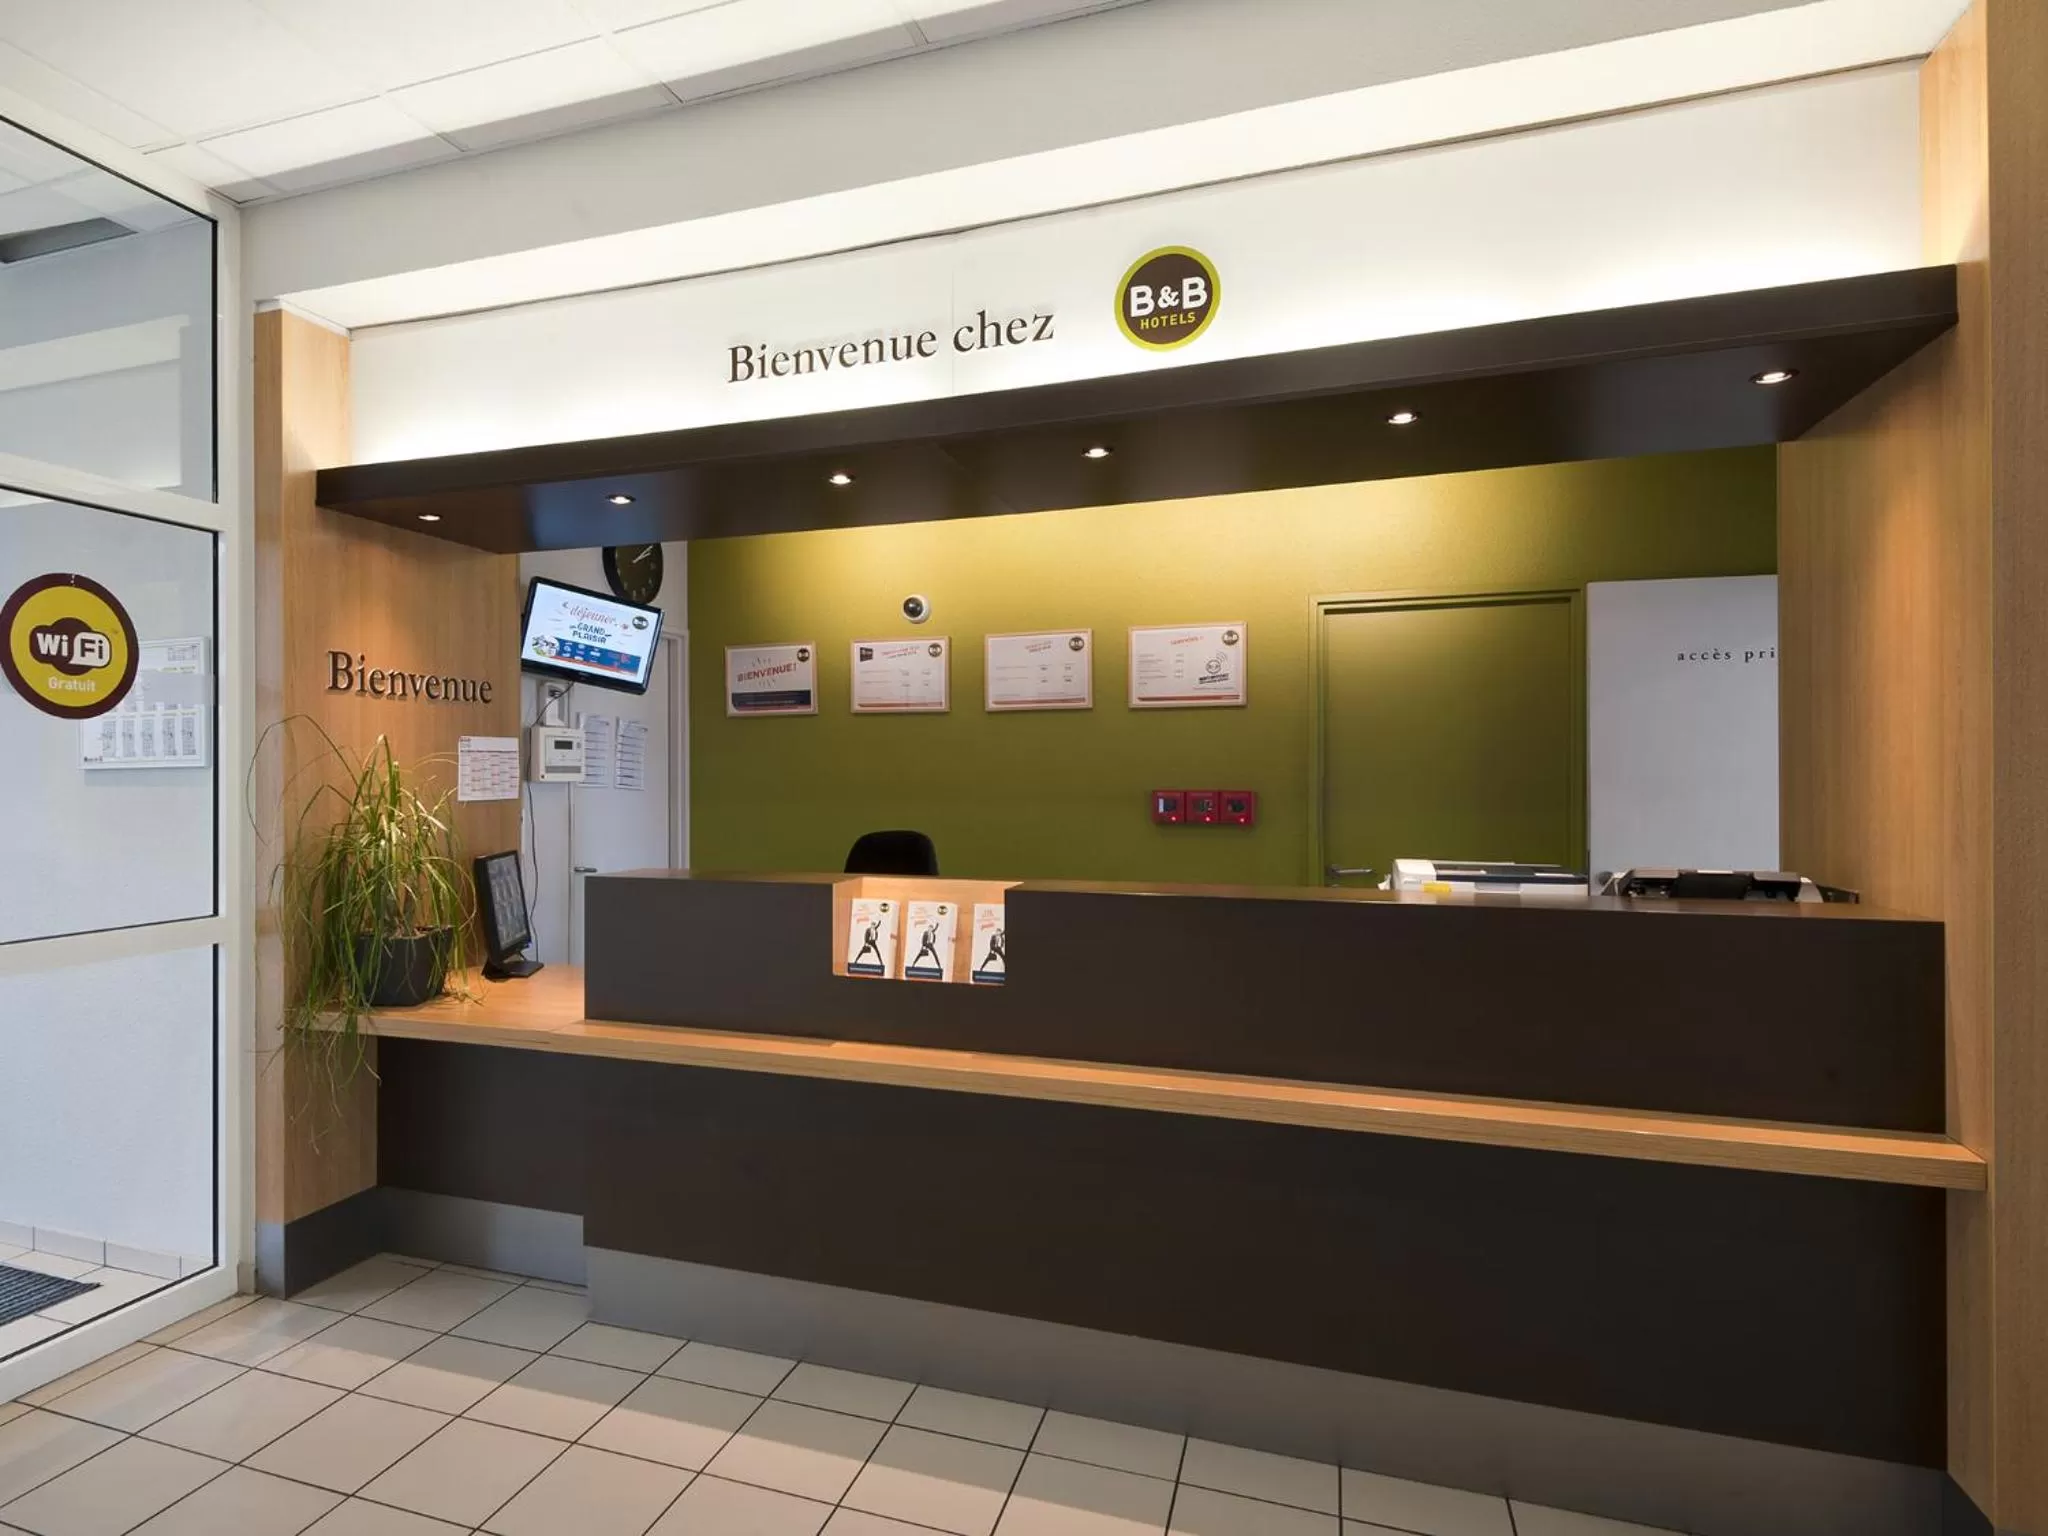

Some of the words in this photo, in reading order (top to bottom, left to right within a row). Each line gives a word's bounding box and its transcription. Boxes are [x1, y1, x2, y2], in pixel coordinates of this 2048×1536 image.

[1129, 276, 1208, 318] B&B
[1140, 312, 1196, 331] HOTELS
[727, 326, 938, 384] Bienvenue
[953, 309, 1055, 356] chez
[572, 630, 607, 644] PLAISIR
[577, 622, 606, 636] GRAND
[1677, 648, 1732, 661] accès
[48, 677, 96, 693] Gratuit
[327, 650, 493, 704] Bienvenue
